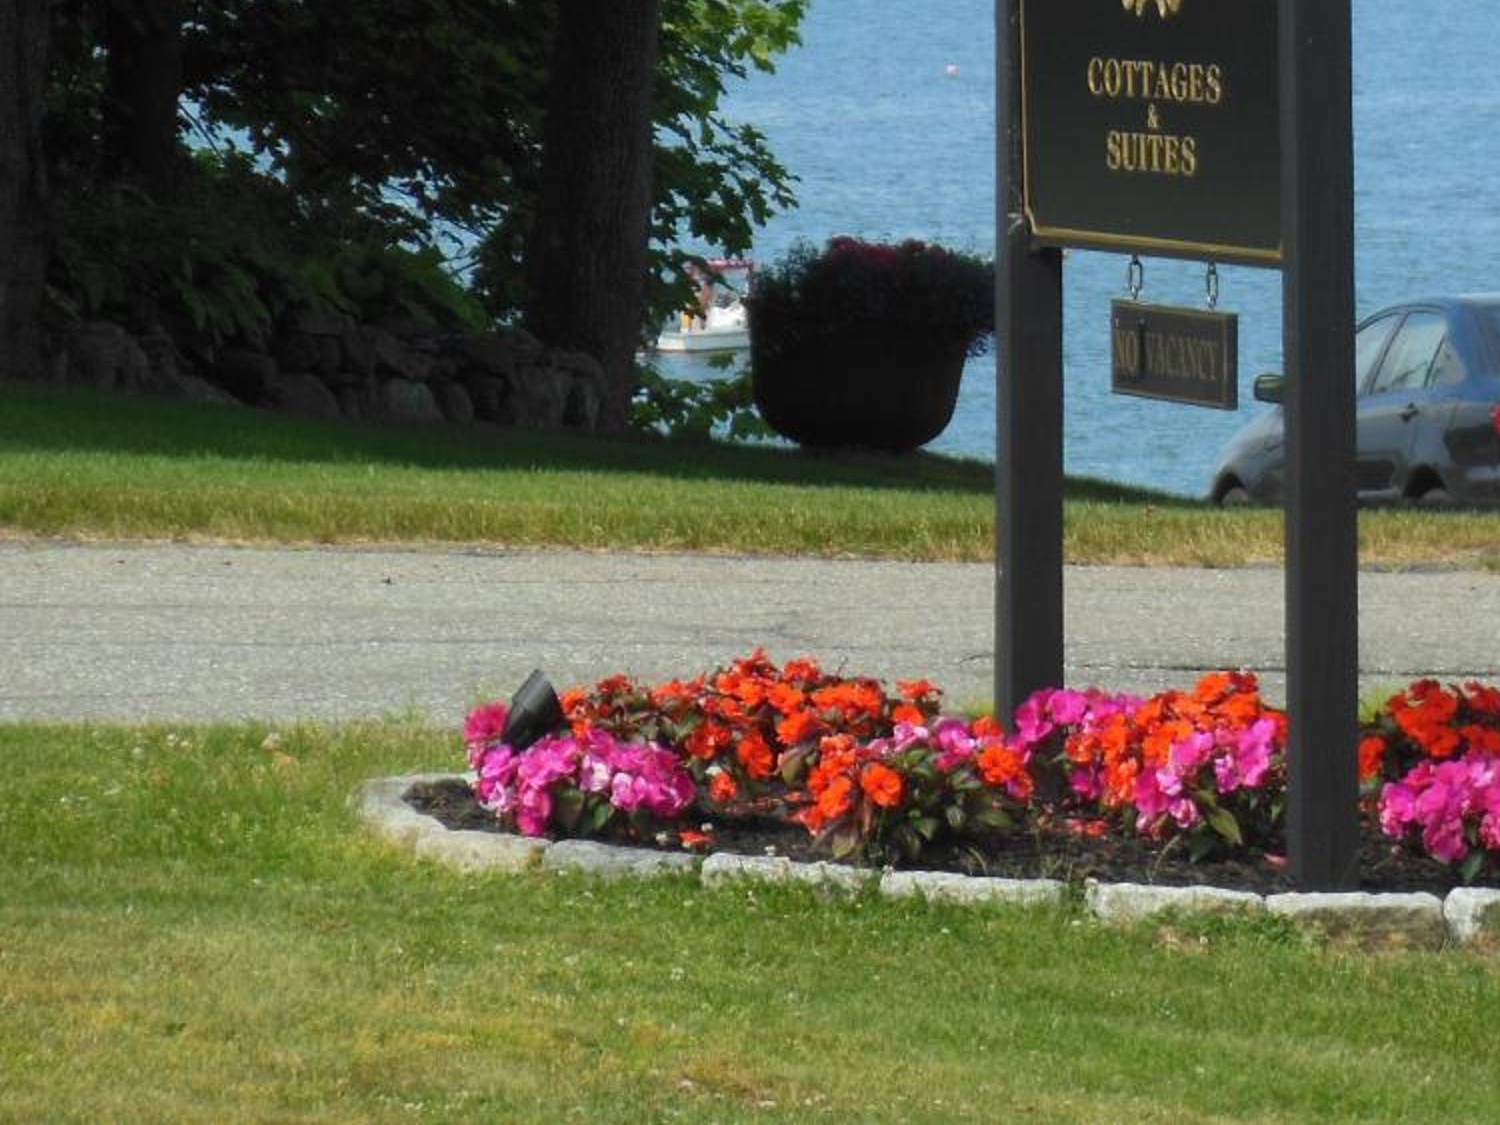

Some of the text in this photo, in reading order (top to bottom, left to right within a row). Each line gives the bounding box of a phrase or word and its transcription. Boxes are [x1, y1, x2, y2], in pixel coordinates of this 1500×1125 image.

[1086, 56, 1223, 104] COTTAGES
[1146, 103, 1160, 130] &
[1105, 129, 1197, 176] SUITES
[1115, 330, 1217, 380] NO VACANCY
